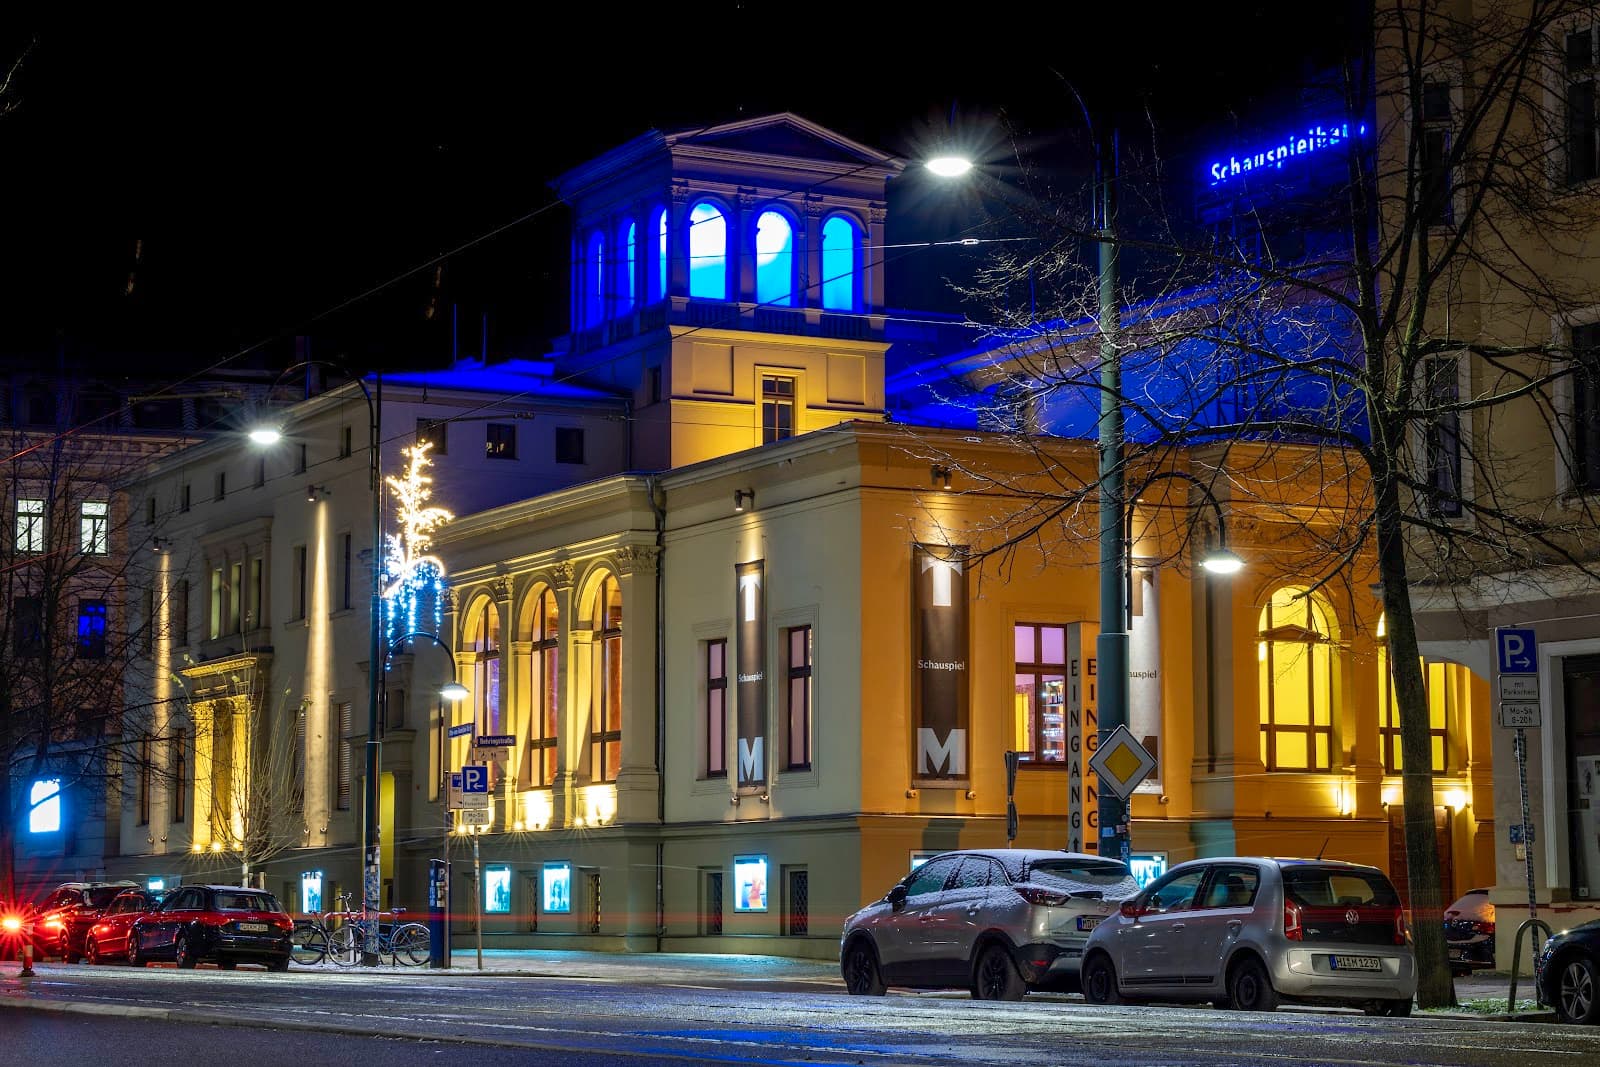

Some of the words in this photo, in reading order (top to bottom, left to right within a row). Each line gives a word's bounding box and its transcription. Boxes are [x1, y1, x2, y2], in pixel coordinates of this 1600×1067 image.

[740, 574, 761, 622] T
[917, 659, 965, 671] Schauspiel
[1504, 634, 1525, 668] P
[738, 671, 763, 683] Schauspiel
[738, 736, 764, 782] M
[917, 728, 966, 775] M
[1070, 659, 1081, 829] EINGANG
[466, 769, 480, 790] P
